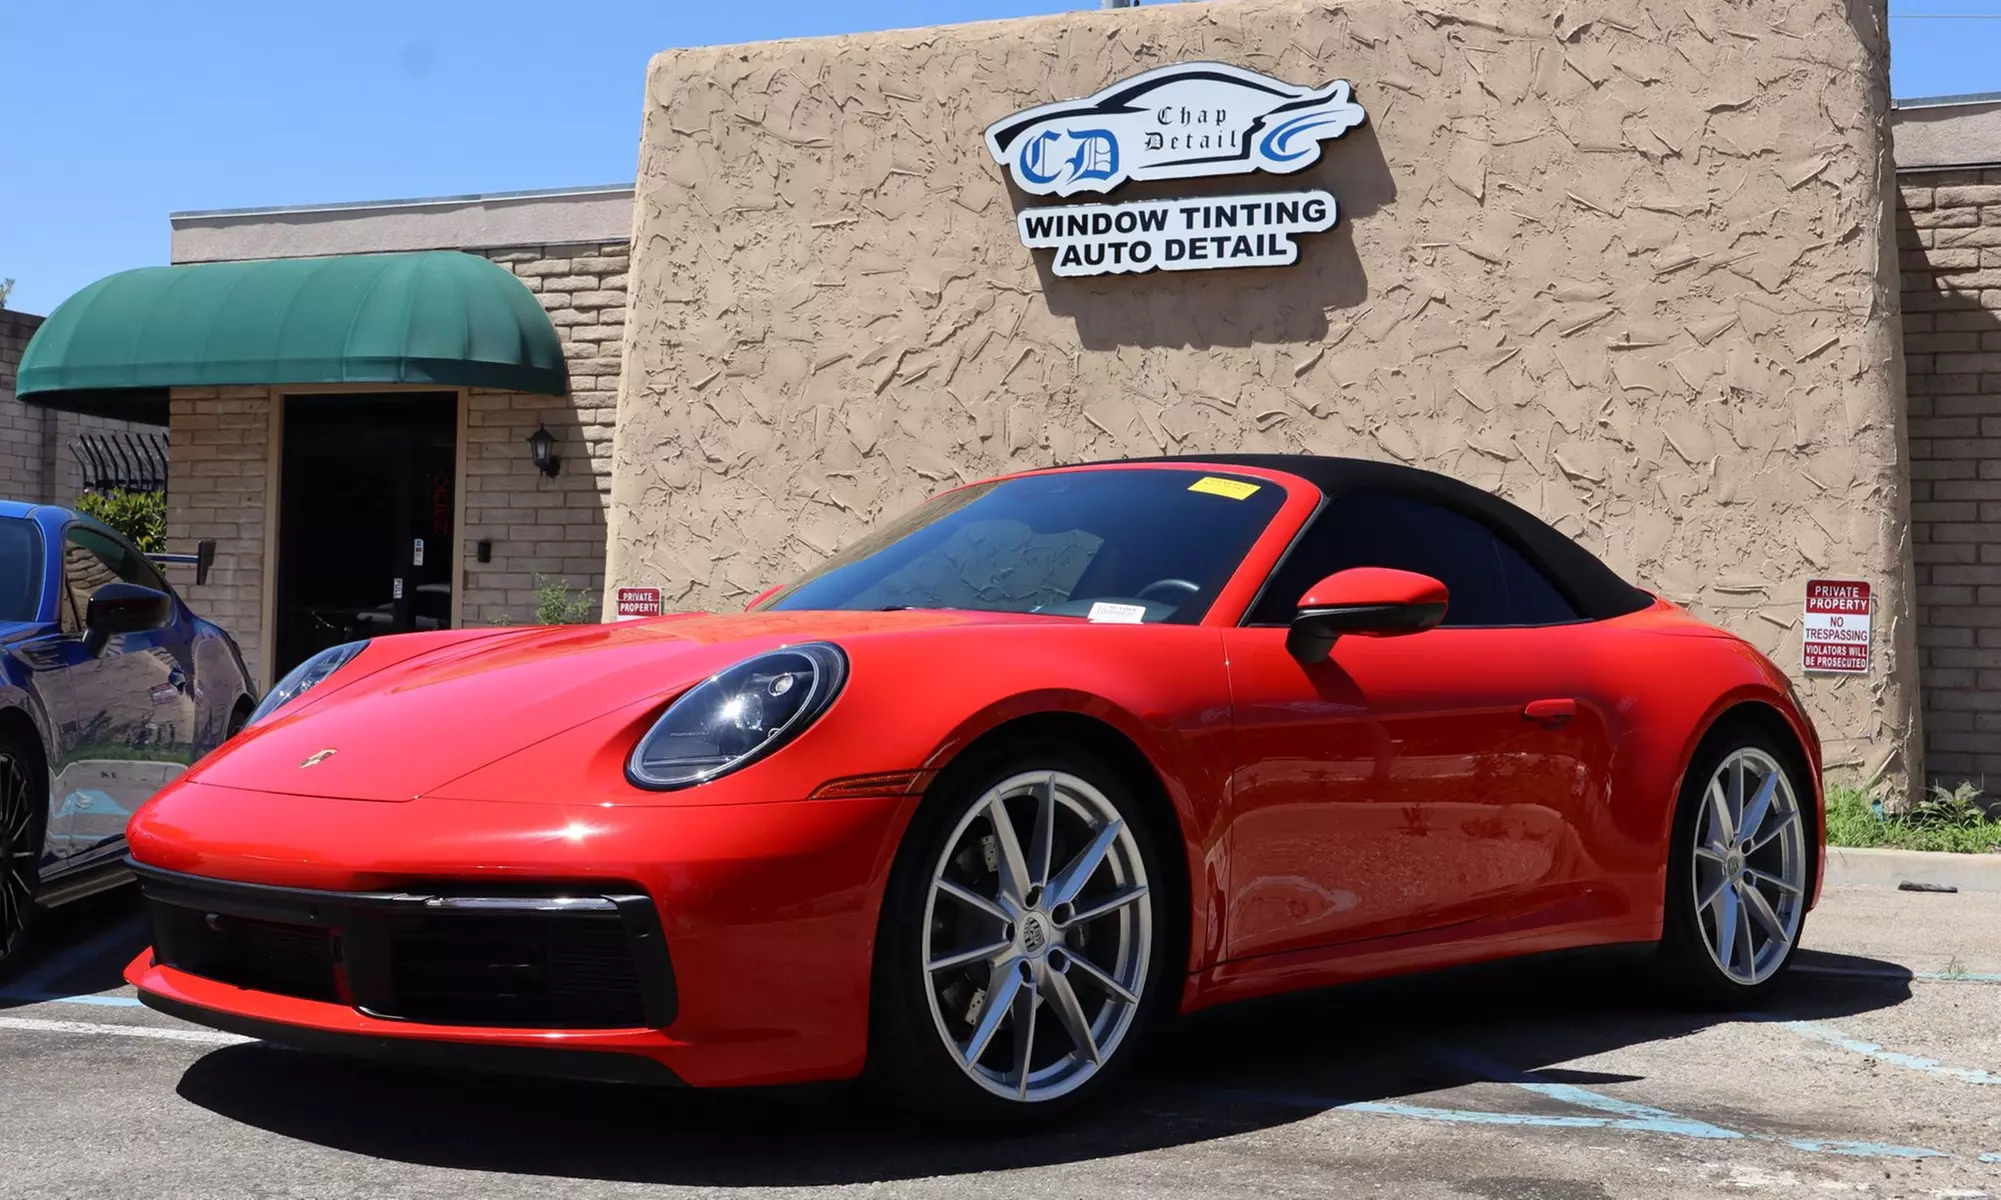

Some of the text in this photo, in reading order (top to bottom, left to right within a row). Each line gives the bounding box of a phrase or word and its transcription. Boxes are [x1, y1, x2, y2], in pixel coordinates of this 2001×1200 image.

[1157, 106, 1227, 127] Chap
[1144, 130, 1238, 151] Detail
[1020, 128, 1119, 185] CD
[1025, 199, 1327, 239] WINDOW TINTING
[1060, 233, 1287, 267] AUTO DETAIL
[623, 592, 653, 601] PRIVATE
[1815, 585, 1859, 597] PRIVATE
[620, 603, 658, 612] PROPERTY
[1809, 598, 1867, 610] PROPERTY
[1830, 616, 1844, 627] NO
[1806, 628, 1868, 641] TRESPASSING
[1805, 645, 1866, 657] VIOLATORS WILL
[1805, 656, 1866, 668] BE PROSECUTED
